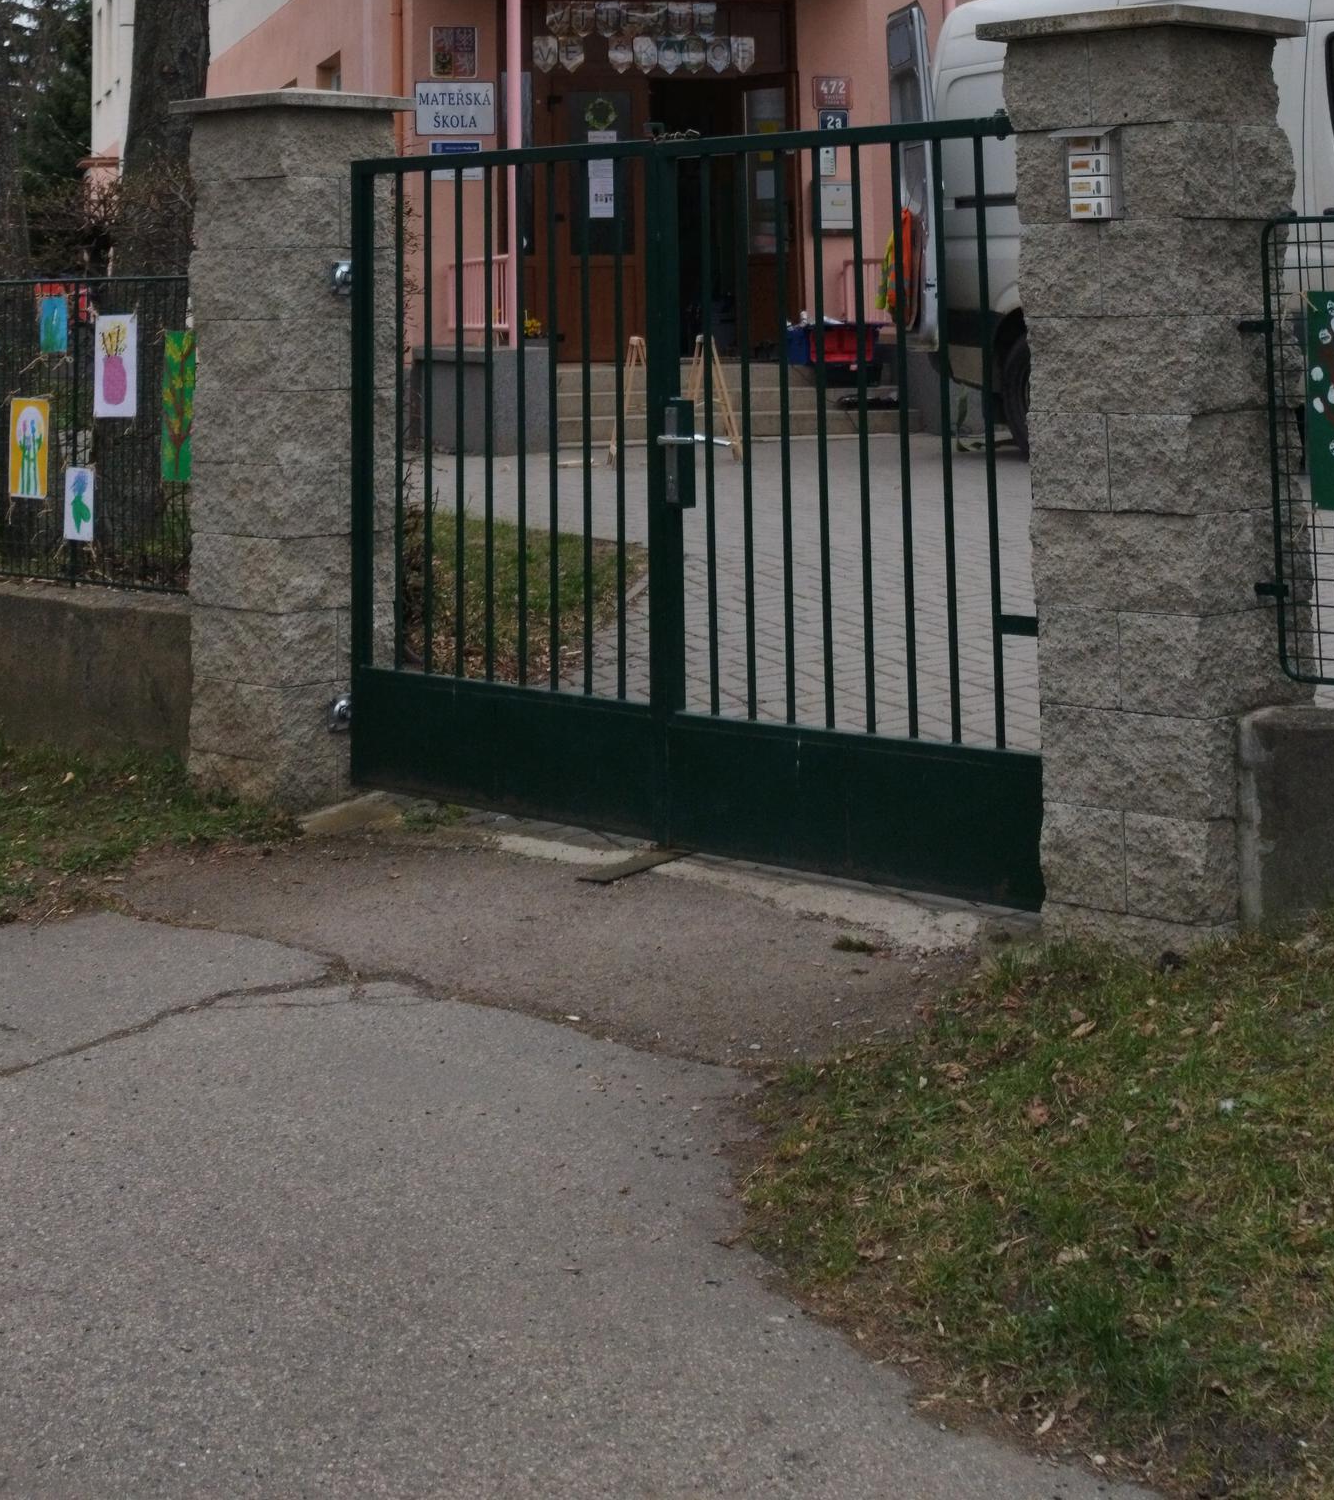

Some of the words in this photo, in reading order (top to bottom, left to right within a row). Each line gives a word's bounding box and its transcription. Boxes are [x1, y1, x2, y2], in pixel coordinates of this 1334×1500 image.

[536, 43, 580, 62] VE
[820, 80, 846, 94] 472
[418, 88, 491, 106] MATEŘSKÁ
[433, 112, 477, 128] ŠKOLA
[827, 115, 842, 129] 2a
